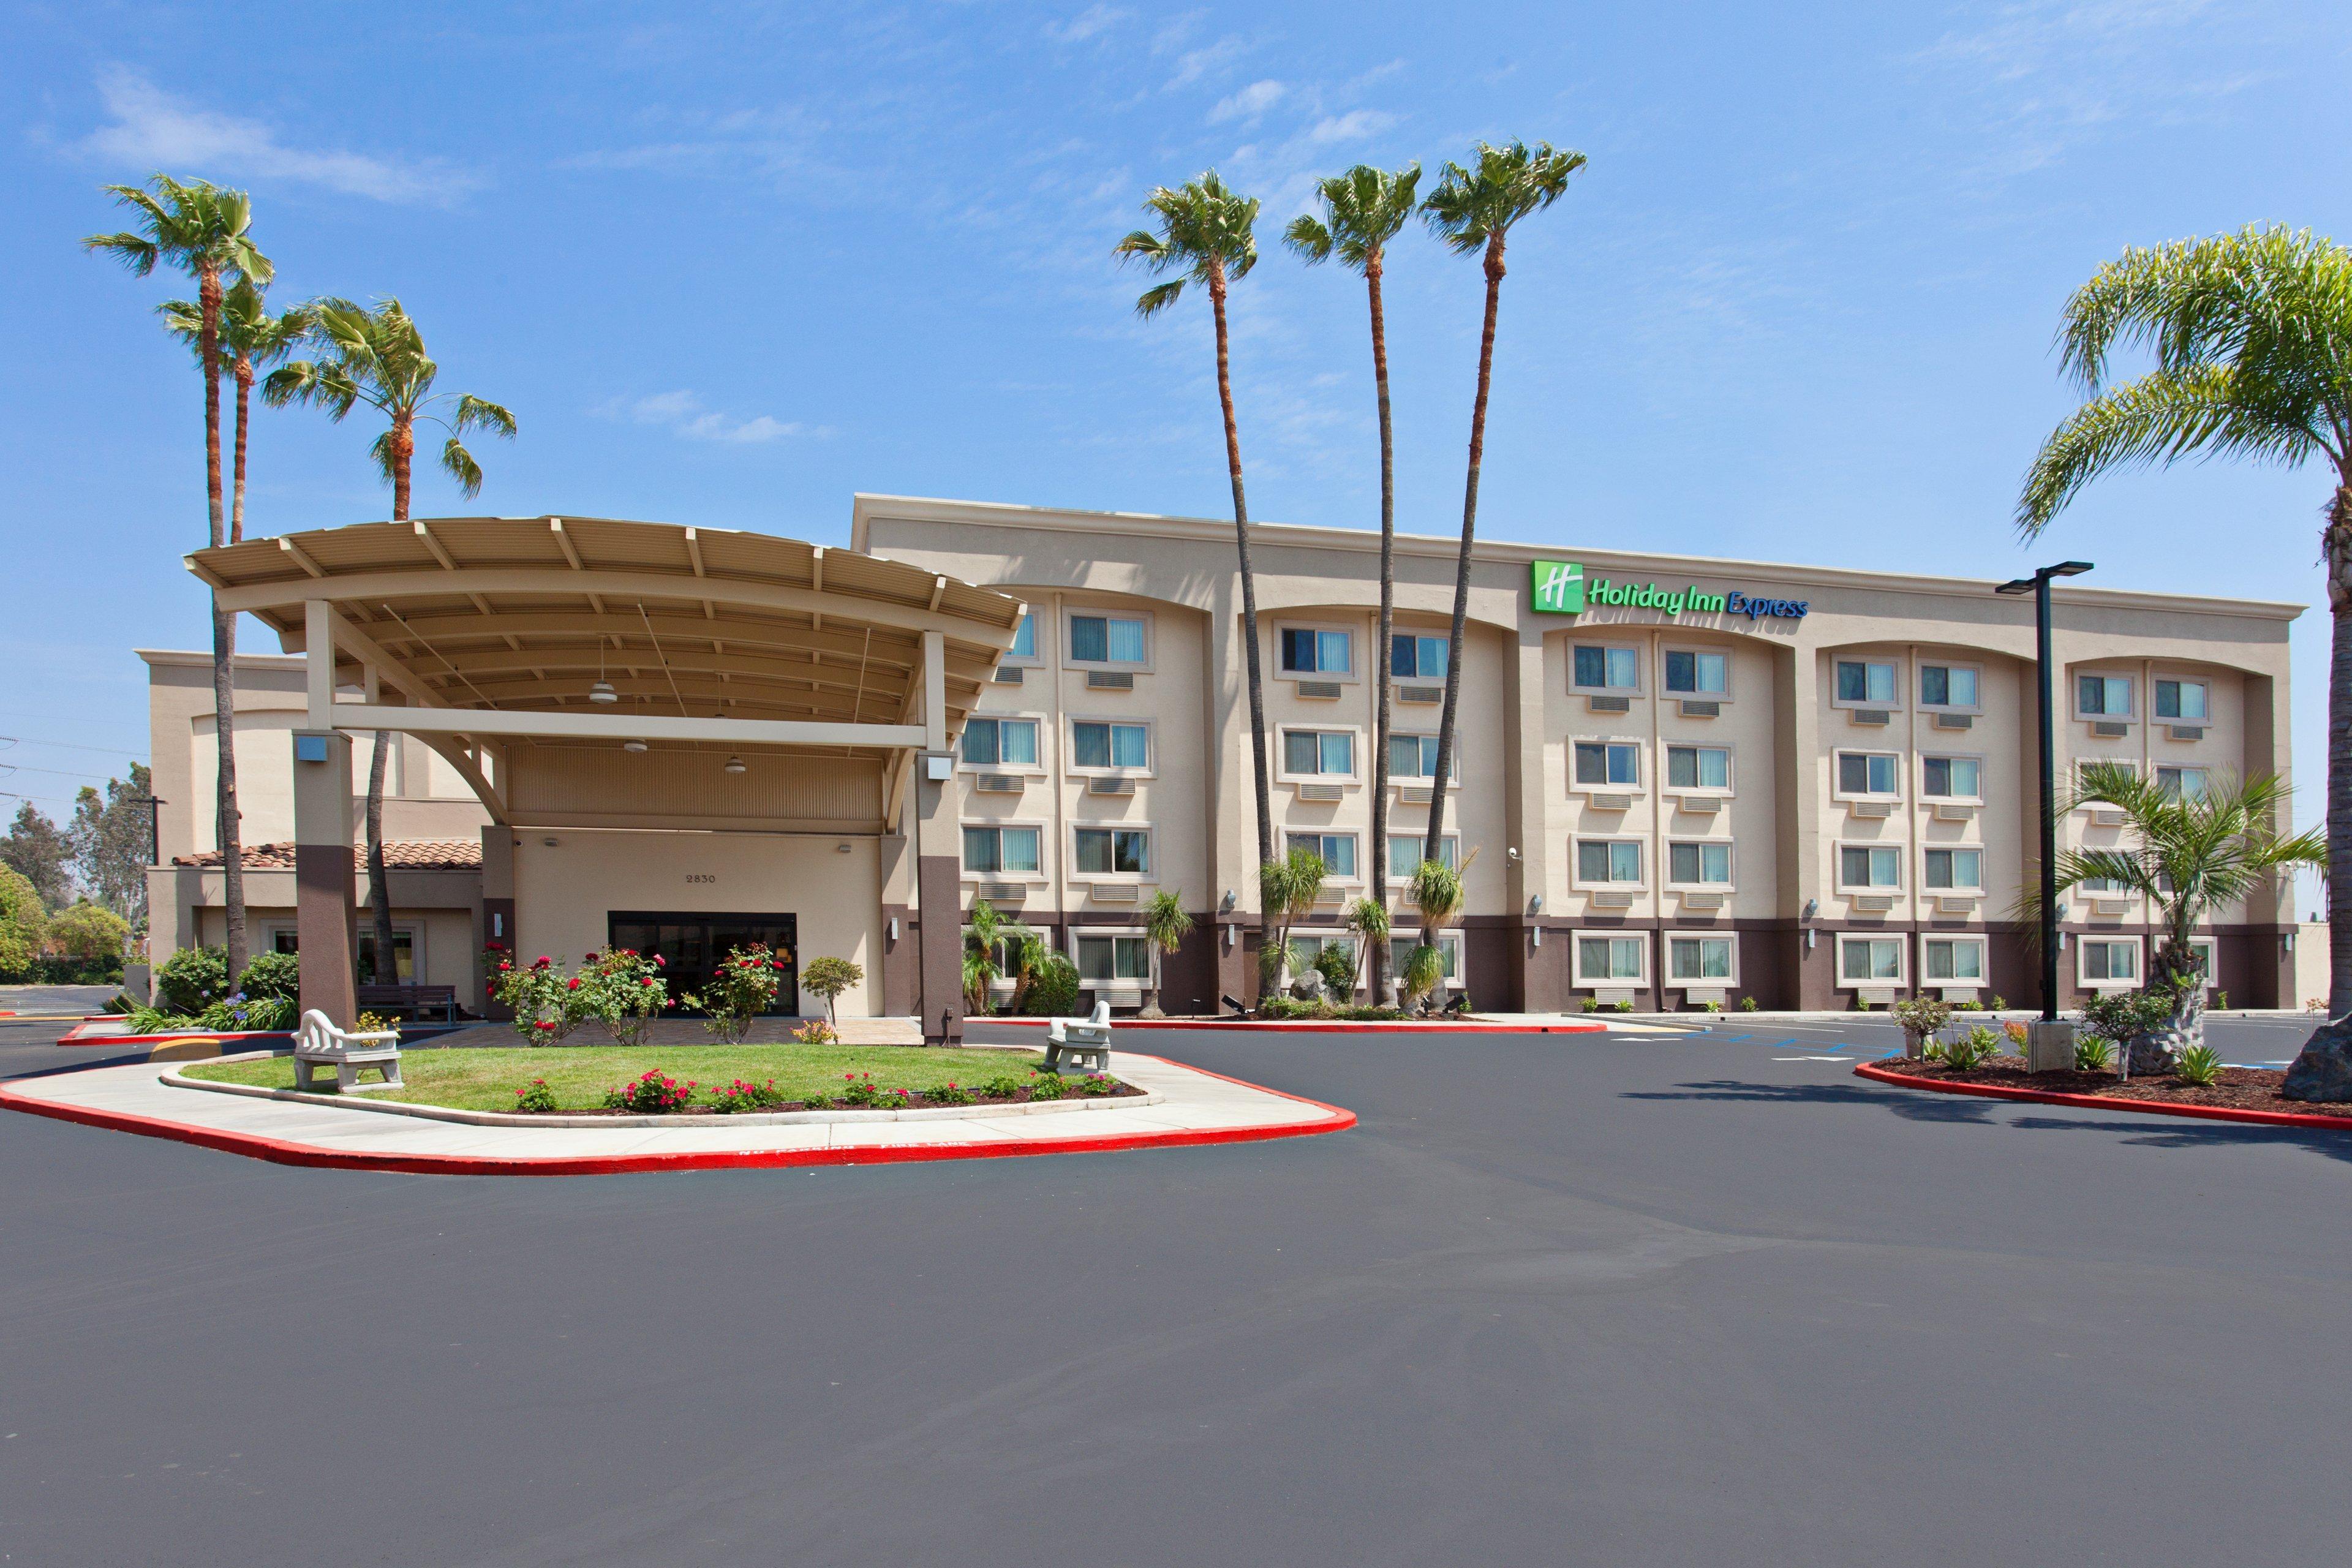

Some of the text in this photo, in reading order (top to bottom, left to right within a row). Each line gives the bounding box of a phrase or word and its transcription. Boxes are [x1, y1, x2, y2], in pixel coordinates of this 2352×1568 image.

[1588, 578, 1809, 620] Holiday Inn Express
